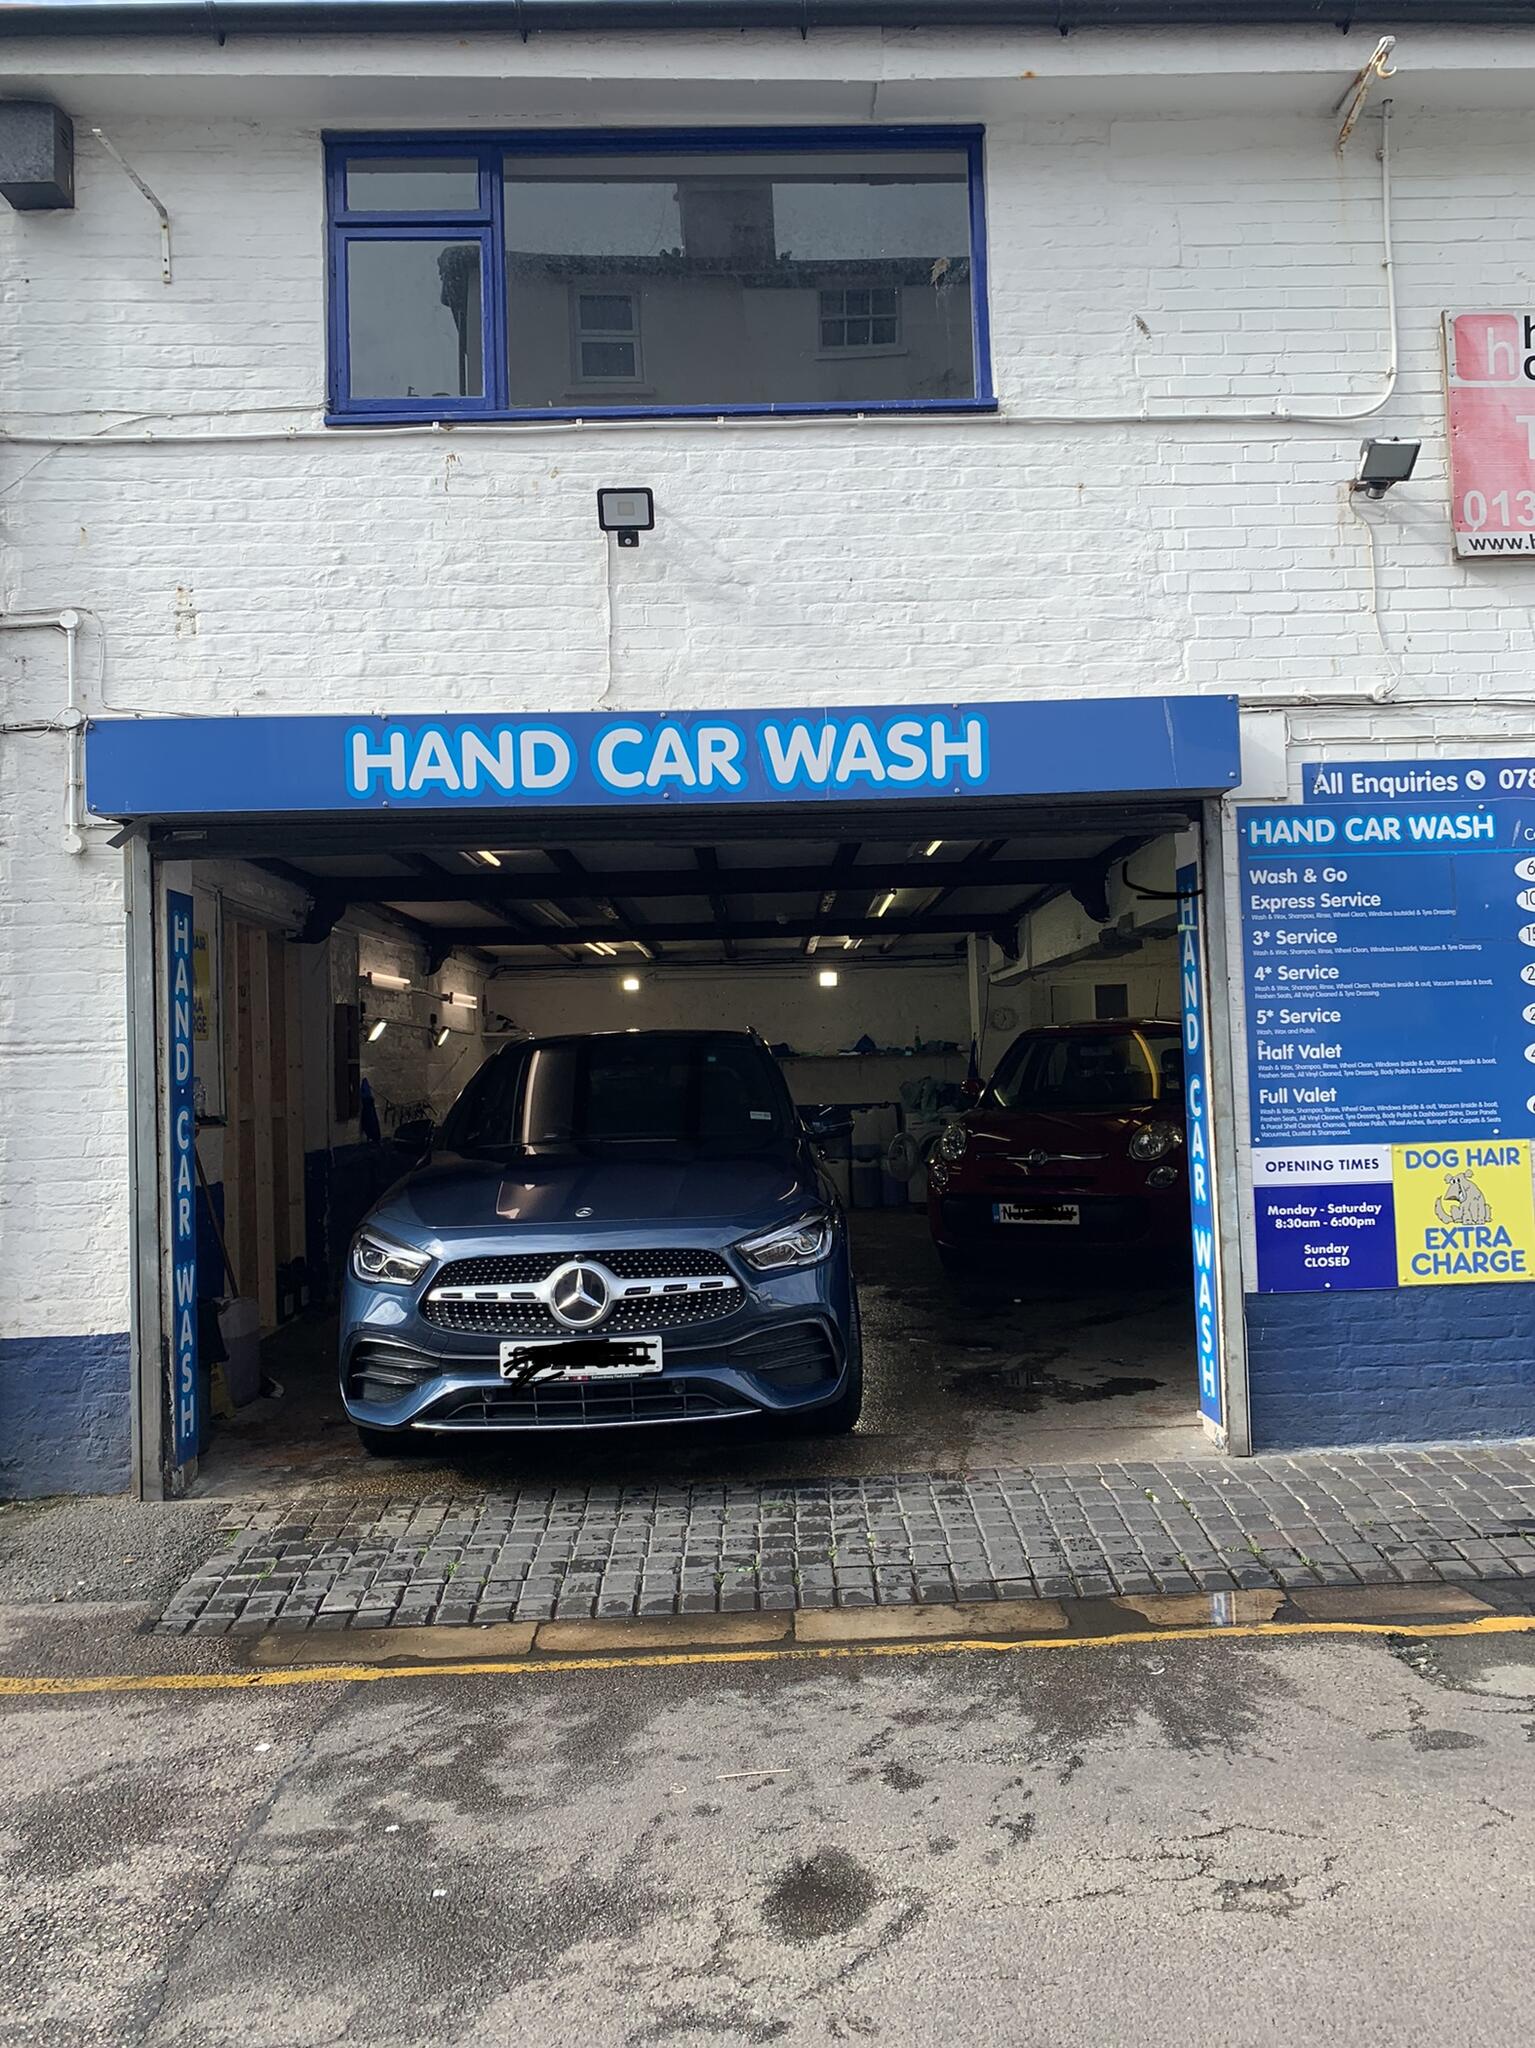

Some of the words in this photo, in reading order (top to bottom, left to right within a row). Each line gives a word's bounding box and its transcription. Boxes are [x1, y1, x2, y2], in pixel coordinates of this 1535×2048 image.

[352, 729, 571, 792] HAND
[597, 726, 740, 789] CAR
[764, 719, 981, 784] WASH
[1314, 773, 1343, 795] All
[1352, 770, 1459, 798] Enquiries
[1250, 819, 1336, 844] HAND
[1344, 817, 1402, 842] CAR
[1408, 814, 1494, 840] WASH
[1249, 868, 1297, 885] Wash
[1304, 868, 1317, 883] &
[1323, 868, 1348, 882] Go
[1251, 894, 1315, 912] Express
[1320, 890, 1381, 908] Service
[1276, 929, 1338, 944] Service
[1181, 888, 1199, 1050] HAND
[1278, 964, 1340, 980] Service
[174, 914, 190, 1082] HAND
[1280, 1008, 1341, 1024] Service
[1258, 1044, 1294, 1061] Half
[1298, 1043, 1342, 1060] Valet
[1259, 1088, 1288, 1104] Full
[1292, 1087, 1337, 1103] Valet
[1190, 1078, 1205, 1202] CAR
[1265, 1160, 1334, 1173] OPENING
[1339, 1158, 1380, 1170] TIMES
[1404, 1150, 1460, 1169] DOG
[1466, 1147, 1520, 1167] HAIR
[176, 1110, 192, 1238] CAR
[1267, 1205, 1318, 1218] Monday
[1327, 1204, 1382, 1218] Saturday
[1275, 1218, 1321, 1229] 8:30am
[1330, 1216, 1376, 1229] 6:00pm
[1424, 1226, 1512, 1250] EXTRA
[1304, 1244, 1350, 1256] Sunday
[1304, 1256, 1350, 1268] CLOSED
[1411, 1250, 1526, 1276] CHARGE
[1194, 1228, 1216, 1398] WASH
[176, 1264, 194, 1438] WASH
